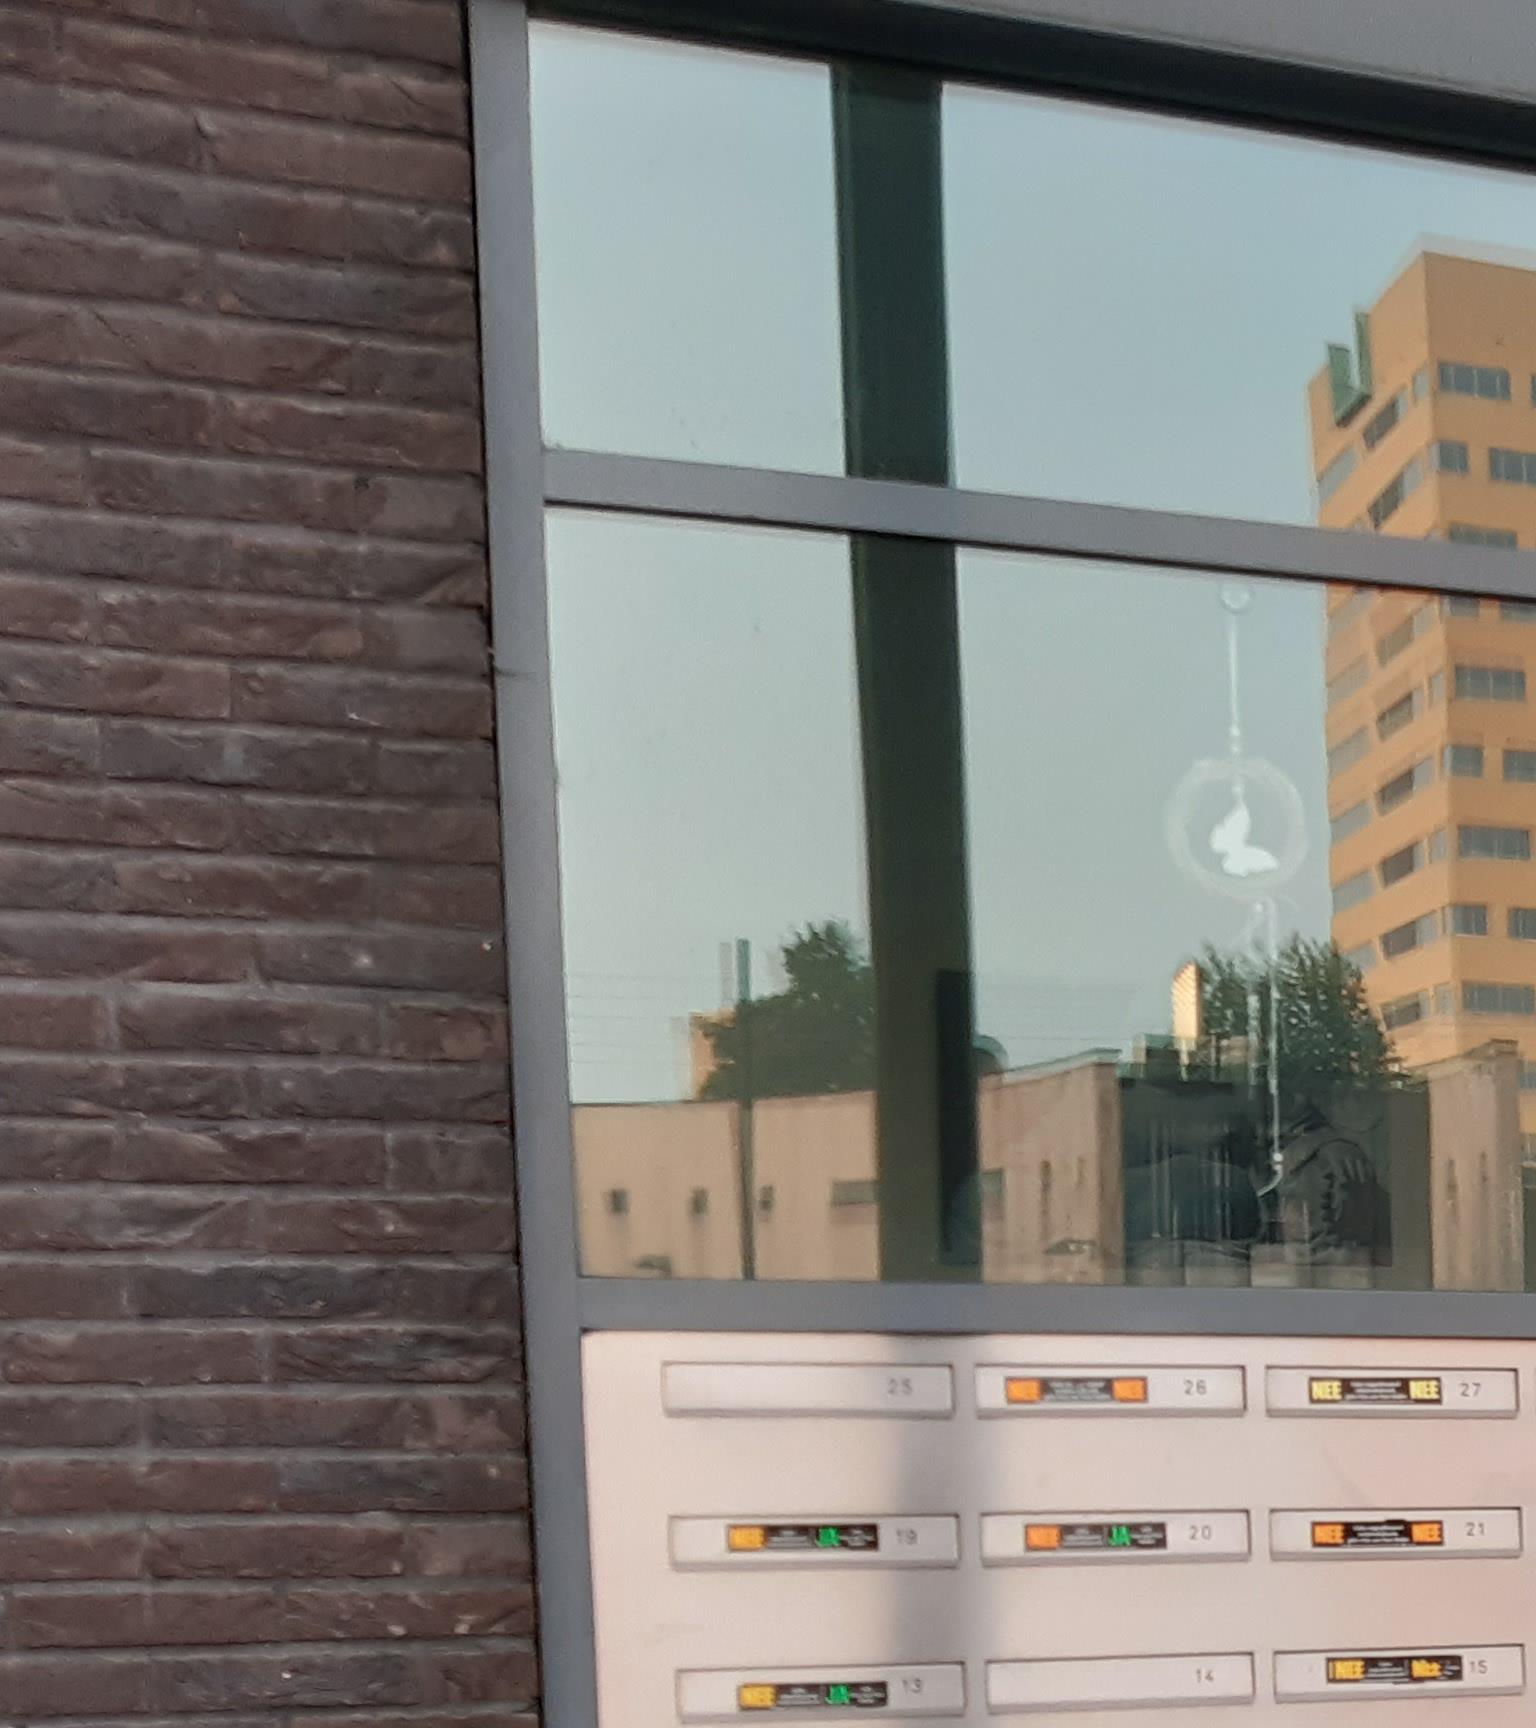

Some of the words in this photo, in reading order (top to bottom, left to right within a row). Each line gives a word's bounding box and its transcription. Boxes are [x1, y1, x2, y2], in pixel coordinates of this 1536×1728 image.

[1459, 1382, 1482, 1398] 27
[1188, 1525, 1212, 1541] 20
[1465, 1522, 1486, 1537] 21
[1469, 1660, 1489, 1674] 15
